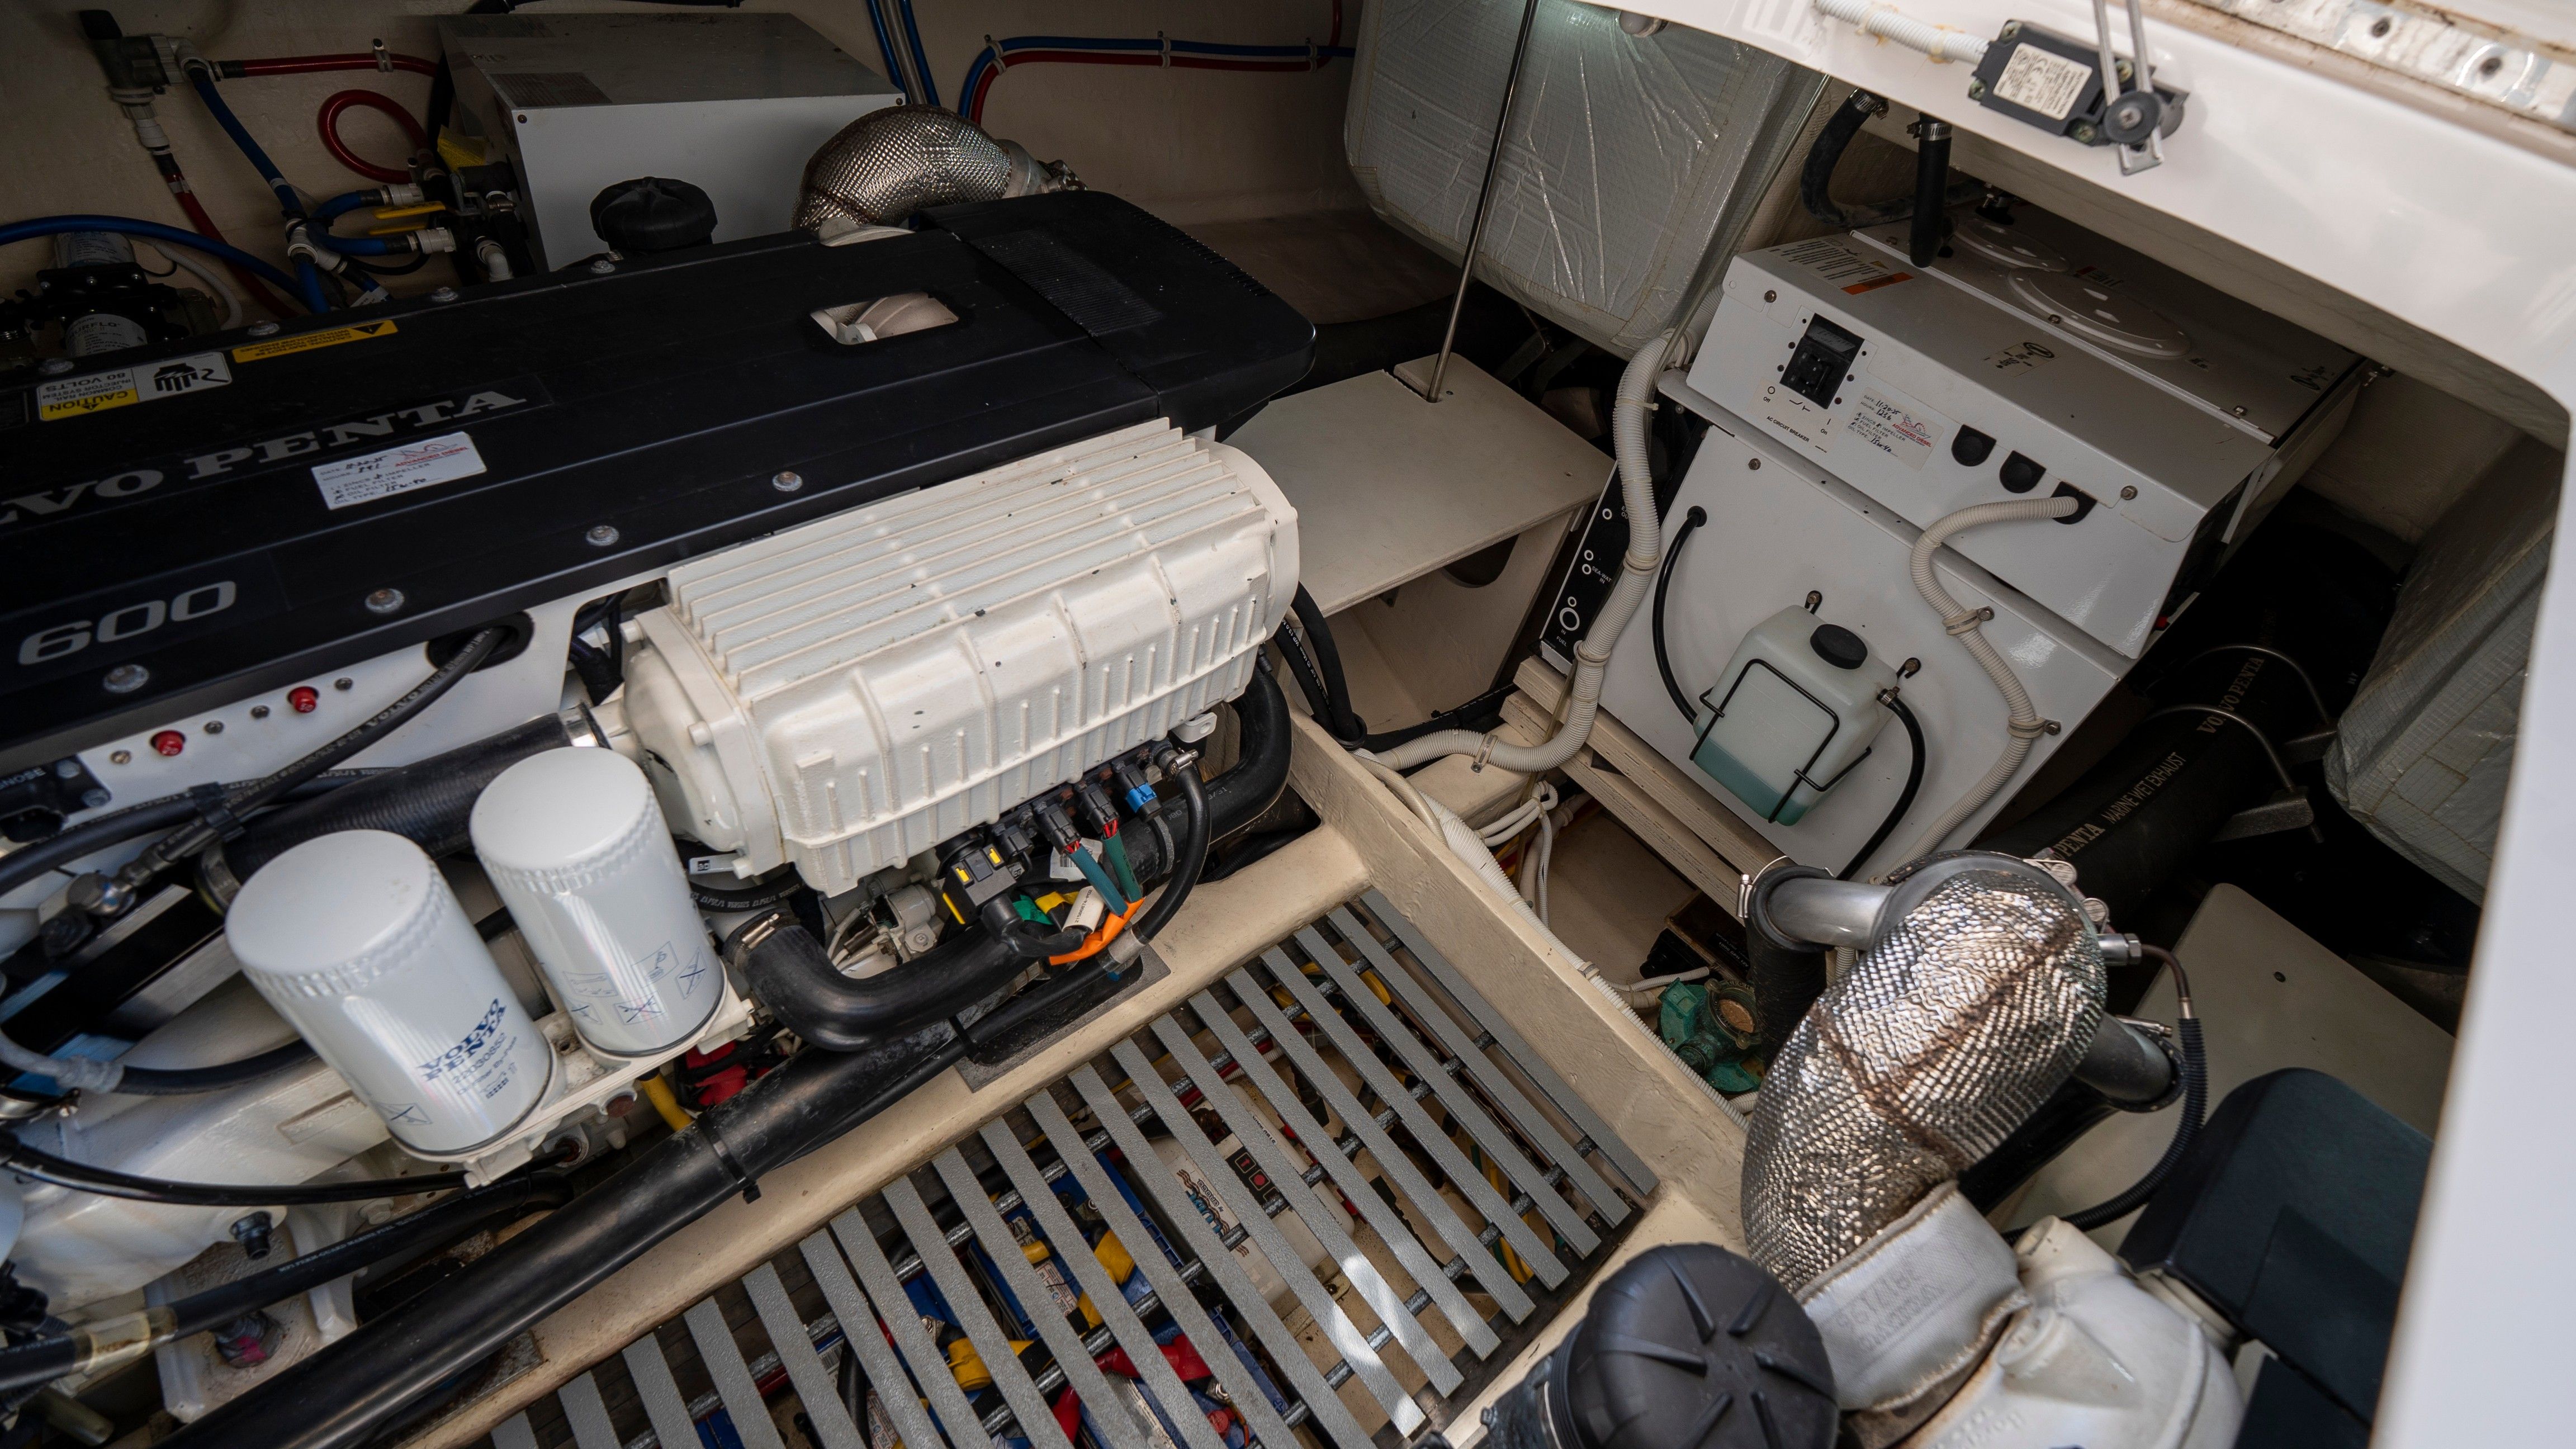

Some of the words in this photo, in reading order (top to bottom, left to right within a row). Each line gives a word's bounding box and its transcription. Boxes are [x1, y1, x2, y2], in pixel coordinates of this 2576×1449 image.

[45, 376, 101, 393] VOLTS
[84, 378, 130, 391] INJECTOR
[106, 371, 125, 381] 80
[42, 387, 82, 399] SYSTEM
[50, 389, 128, 413] CAUTION
[54, 392, 78, 402] RAIL
[82, 385, 122, 396] COMMON
[184, 391, 527, 480] PENTA
[1773, 419, 1789, 431] CIRCUIT
[1789, 428, 1810, 442] BREAKER
[1859, 419, 1872, 429] FUEL
[1872, 427, 1889, 438] FILTER
[1861, 415, 1876, 425] ZINCS
[1882, 425, 1906, 442] IMPELLER
[1865, 429, 1882, 440] FILTER
[1891, 423, 1917, 439] ADVANCED
[1916, 436, 1933, 448] DIESEL
[394, 453, 441, 467] ADVANCED
[442, 446, 468, 456] DIESEL
[385, 462, 430, 476] IMPELLER
[344, 482, 368, 491] FUEL
[371, 473, 404, 485] FILTER
[365, 480, 397, 491] FILTER
[18, 581, 237, 666] 600
[1556, 635, 1566, 646] FUEL
[2195, 690, 2241, 734] VOVO
[2228, 654, 2266, 697] PENTA
[366, 689, 420, 729] VOLVO
[2054, 822, 2105, 857] PENTA
[2100, 793, 2139, 825] MARINE
[2129, 779, 2153, 802] WET
[2145, 750, 2187, 787] EXHAUST
[416, 997, 499, 1072] VOLVO
[421, 1006, 506, 1081] PENTA
[452, 1032, 507, 1084] 22030852
[475, 1068, 494, 1083] Filter
[1196, 1179, 1220, 1207] GROCO
